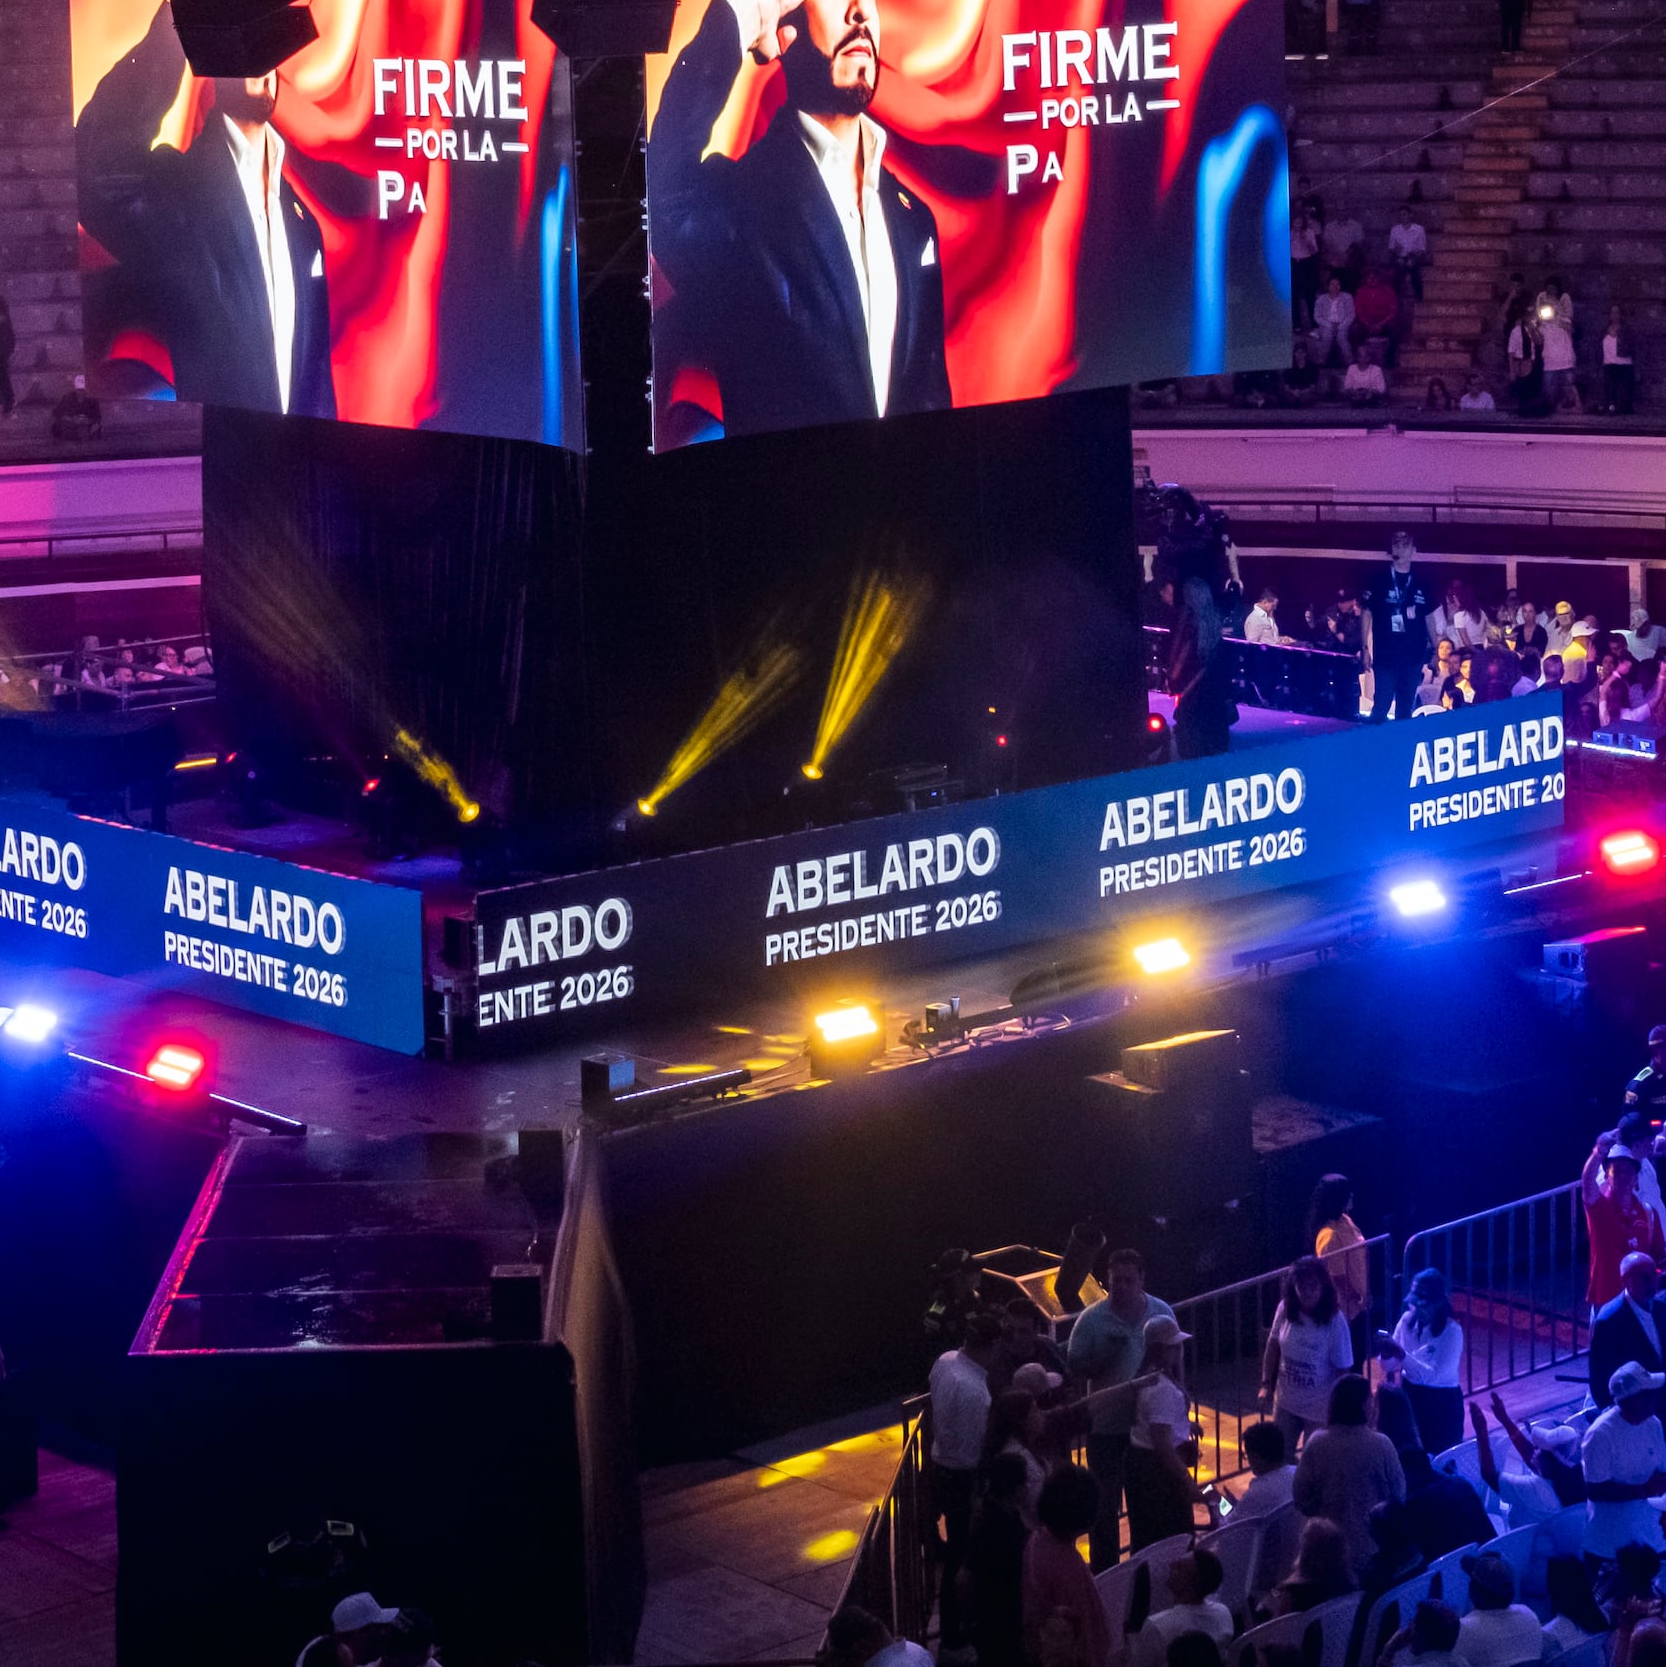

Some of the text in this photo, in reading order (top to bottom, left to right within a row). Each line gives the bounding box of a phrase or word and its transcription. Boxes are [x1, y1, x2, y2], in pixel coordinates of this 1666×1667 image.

[373, 56, 529, 121] FIRME
[1002, 21, 1180, 92] FIRME
[1042, 92, 1142, 129] POR LA
[407, 128, 499, 162] POR LA
[1006, 143, 1064, 194] PA
[377, 169, 427, 220] PA
[1410, 716, 1564, 788] ABELARD
[1100, 768, 1303, 852] ABELARDO
[1410, 772, 1566, 831] PRESIDENTE 20
[766, 828, 996, 918] ABELARDO
[1099, 827, 1304, 898] PRESIDENTE 2026
[41, 899, 87, 939] 2026
[164, 866, 343, 955] ABELARDO
[765, 890, 1001, 967] PRESIDENTE 2026
[164, 930, 344, 1007] PRESIDENTE 2026
[479, 965, 633, 1027] ENTE 2026
